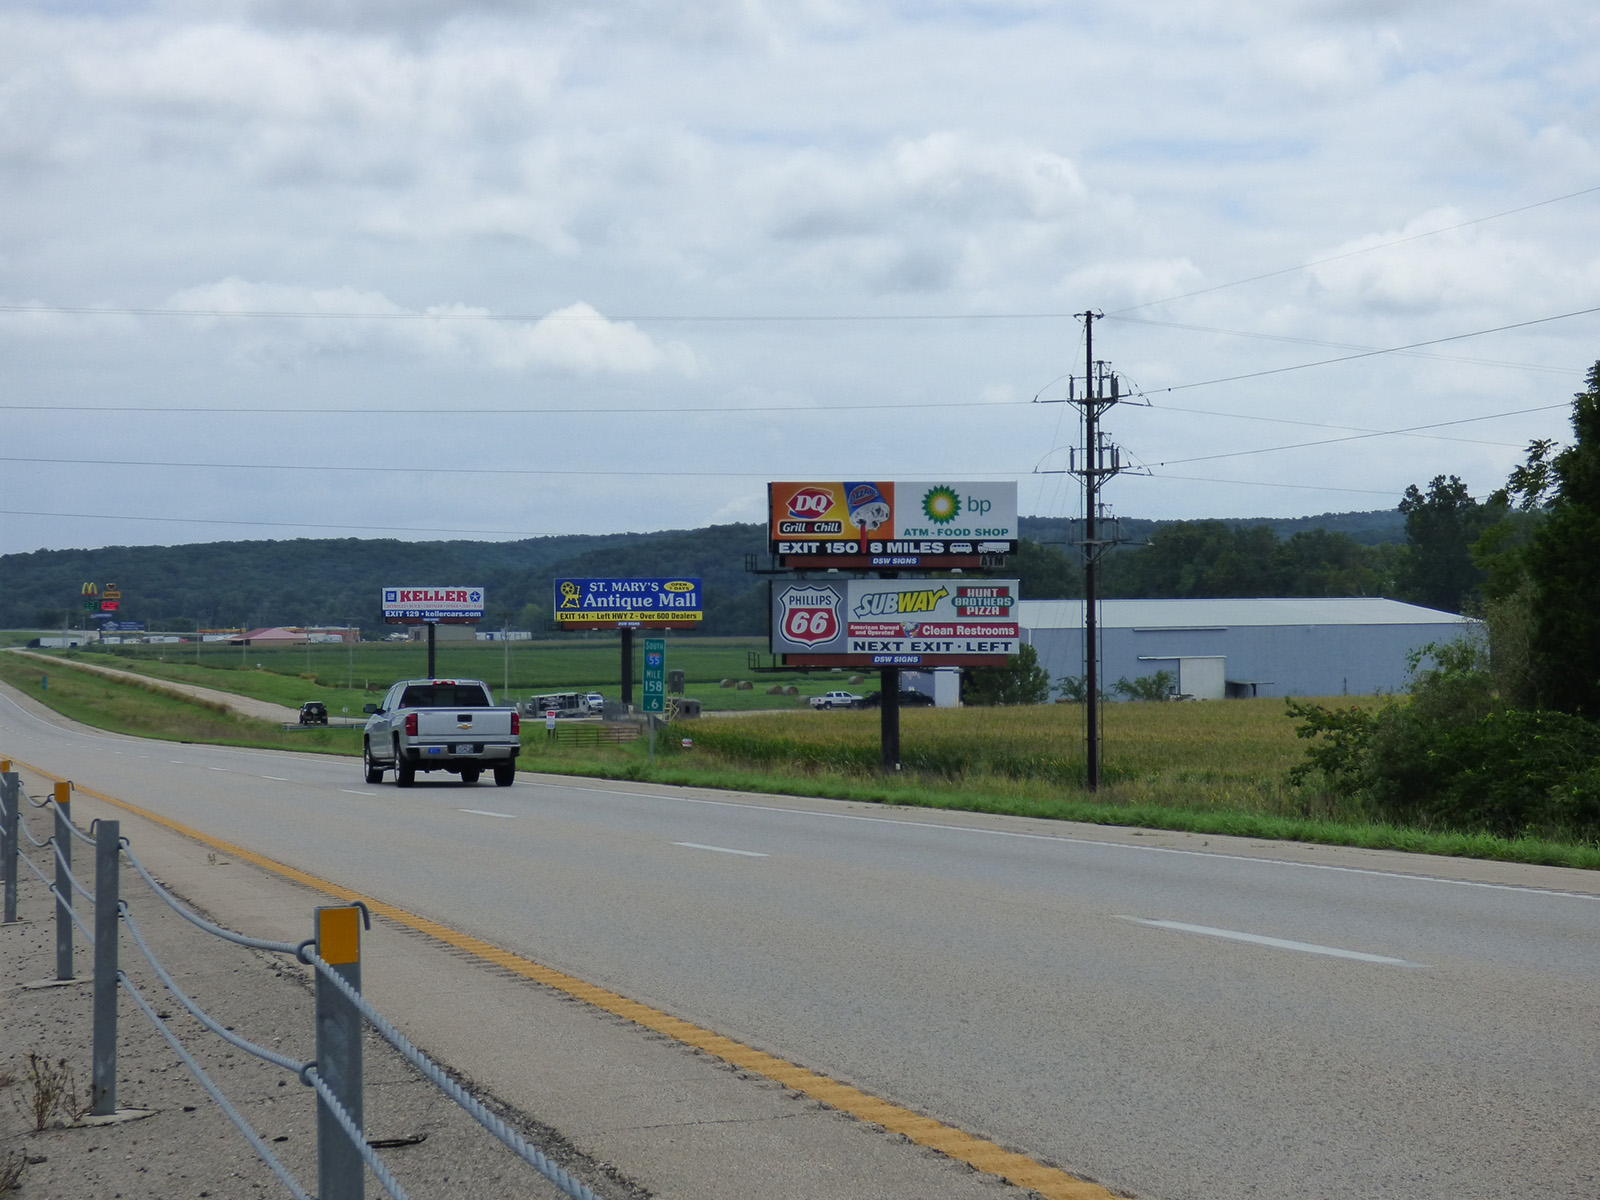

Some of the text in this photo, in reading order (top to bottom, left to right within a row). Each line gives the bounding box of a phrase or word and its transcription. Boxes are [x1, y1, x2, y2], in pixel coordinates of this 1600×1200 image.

[795, 495, 828, 513] DQ
[968, 495, 991, 516] bp
[782, 522, 838, 532] Grill Chill
[904, 528, 929, 536] ATM
[937, 528, 971, 537] FOOD
[975, 528, 1009, 537] SHOP
[779, 542, 945, 554] EXIT 150 8 MILES
[589, 582, 659, 592] ST. MARY'S
[400, 590, 468, 602] KELLER
[967, 588, 999, 597] HUNT
[583, 593, 697, 610] Antique Mall
[789, 595, 832, 606] PHILLIPS
[853, 585, 949, 619] SUBWAY
[954, 597, 1011, 606] BROTHERS
[966, 606, 1000, 615] PIZZA
[560, 612, 576, 620] EXIT
[578, 612, 589, 620] 141
[596, 612, 611, 620] Left
[612, 612, 628, 620] HWY
[639, 612, 655, 620] Over
[791, 611, 829, 634] 66
[922, 625, 1015, 635] Clean Restrooms
[853, 641, 904, 651] NEXT
[910, 641, 954, 651] EXIT
[966, 641, 1013, 651] LEFT
[649, 656, 660, 665] 55
[646, 670, 661, 679] MILE
[645, 681, 663, 692] 158
